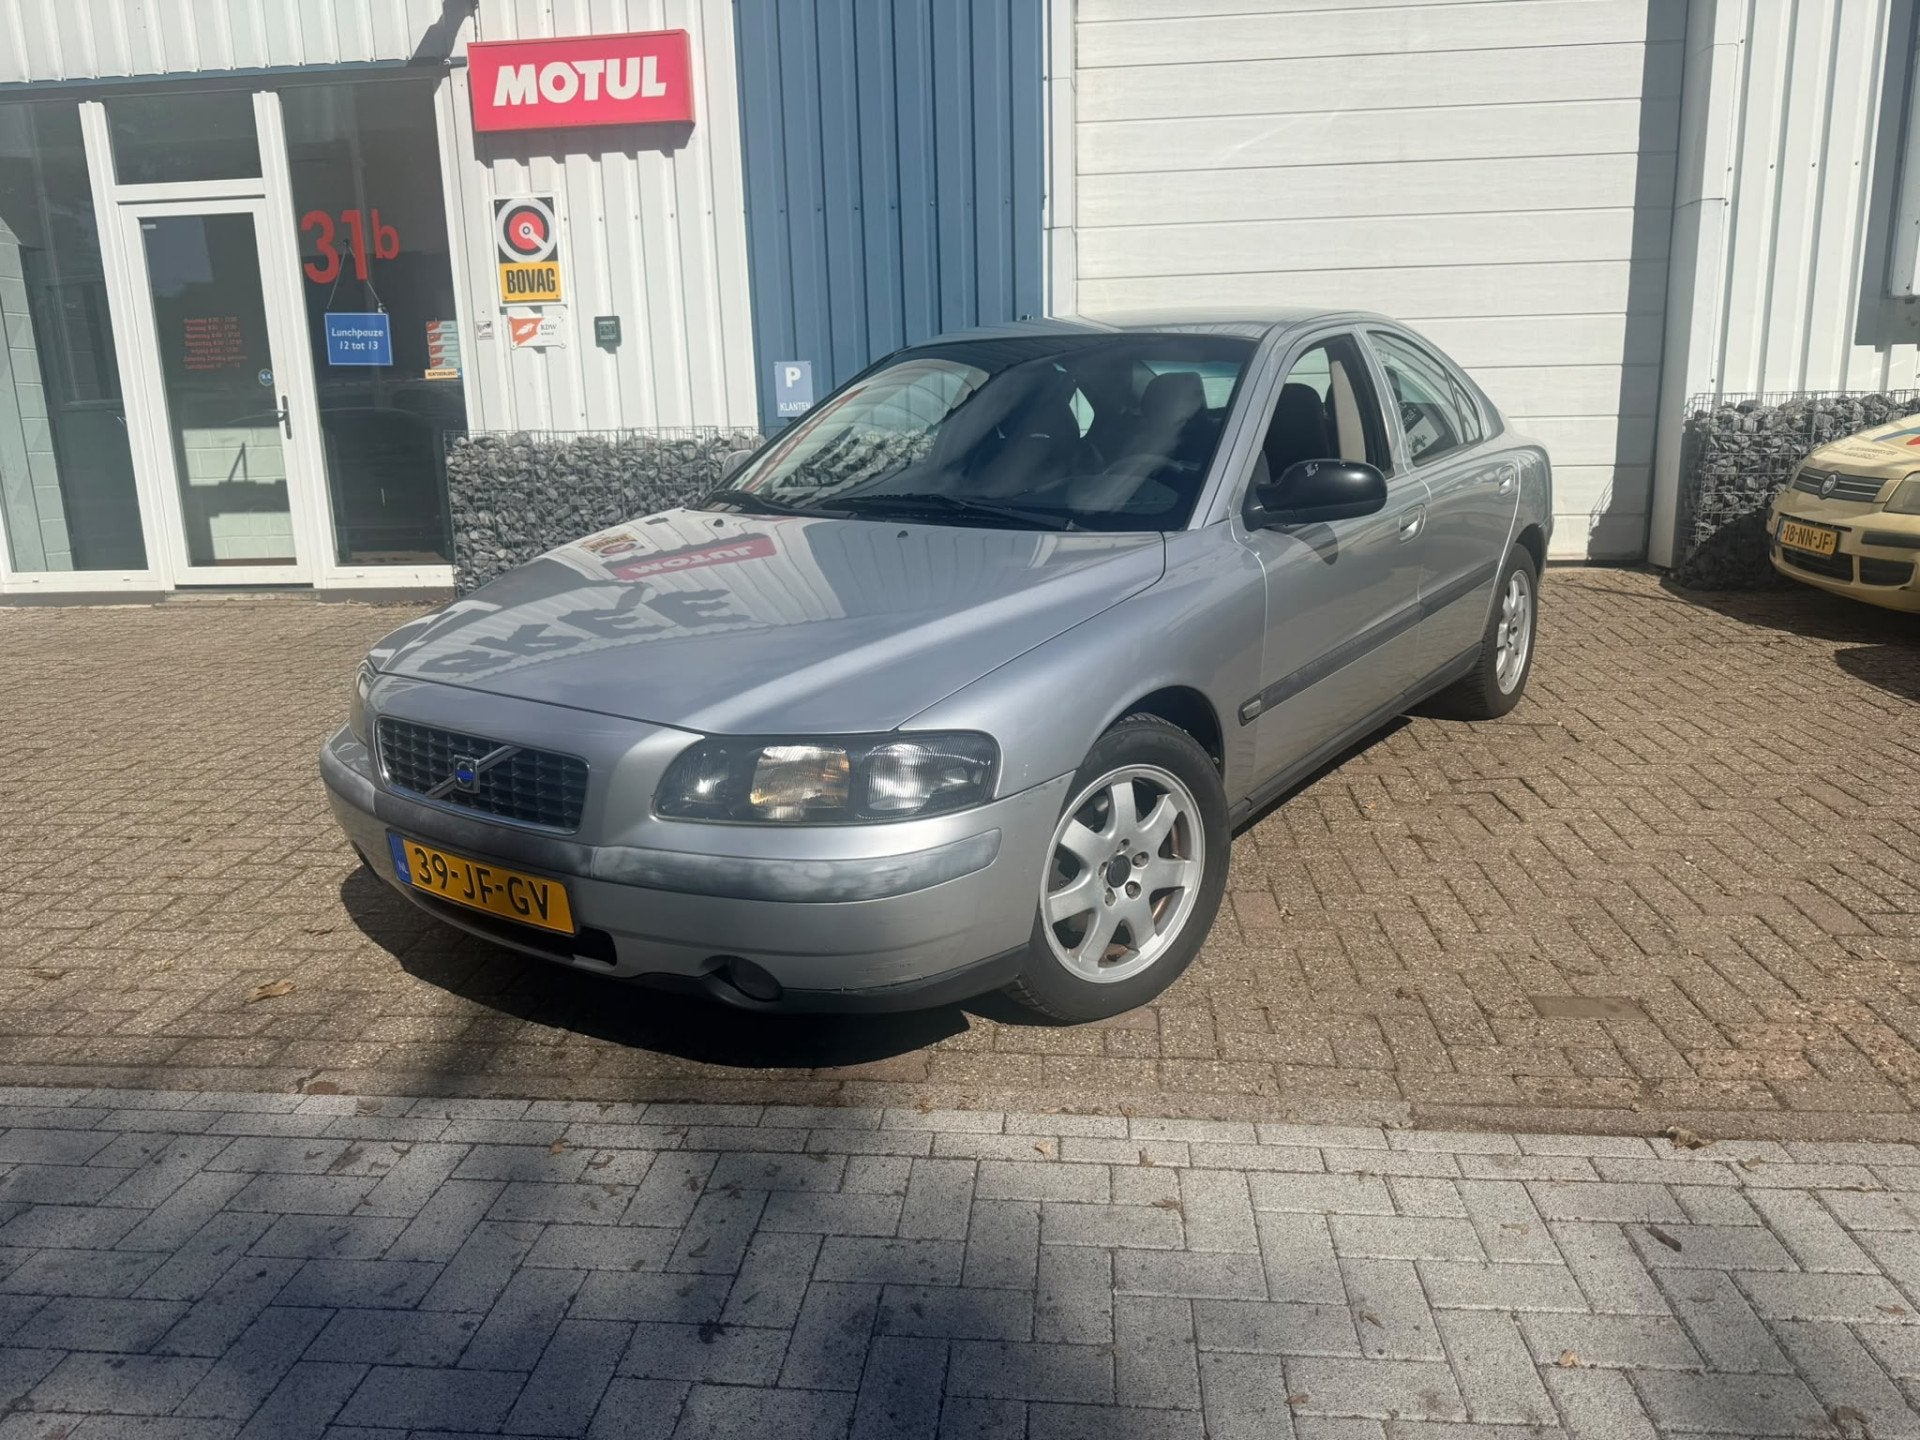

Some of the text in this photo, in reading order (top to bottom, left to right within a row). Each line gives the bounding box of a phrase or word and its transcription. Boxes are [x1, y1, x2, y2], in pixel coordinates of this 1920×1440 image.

[493, 55, 667, 107] MOTUL
[505, 267, 556, 294] BOVAG
[331, 327, 384, 340] Lunchpauze
[340, 341, 379, 350] 12 tot 13
[785, 366, 801, 388] P
[1784, 524, 1831, 551] 18-NN-JF
[414, 847, 548, 921] 39-JF-GV
